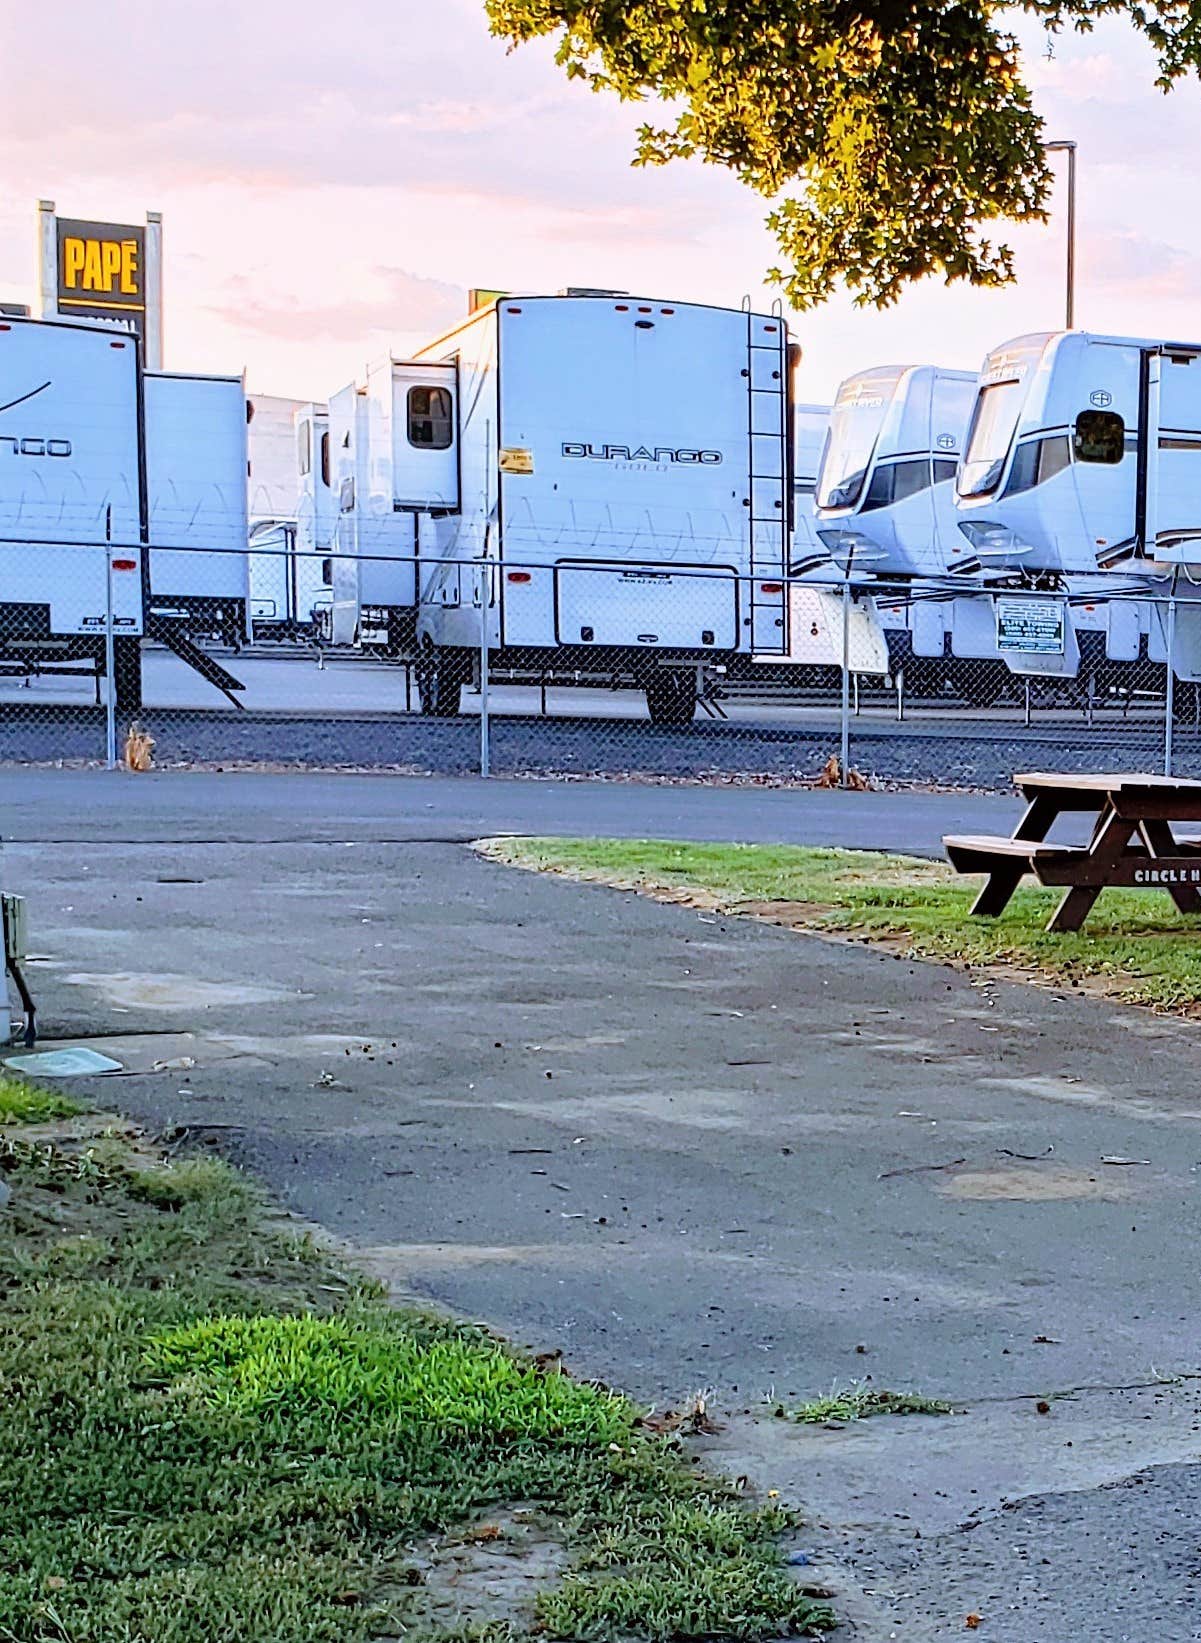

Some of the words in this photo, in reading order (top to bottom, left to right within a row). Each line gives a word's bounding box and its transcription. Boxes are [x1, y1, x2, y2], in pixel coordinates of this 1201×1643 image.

[561, 442, 723, 465] DURANGO
[1134, 869, 1187, 882] CIRCLE
[1191, 869, 1200, 881] H
